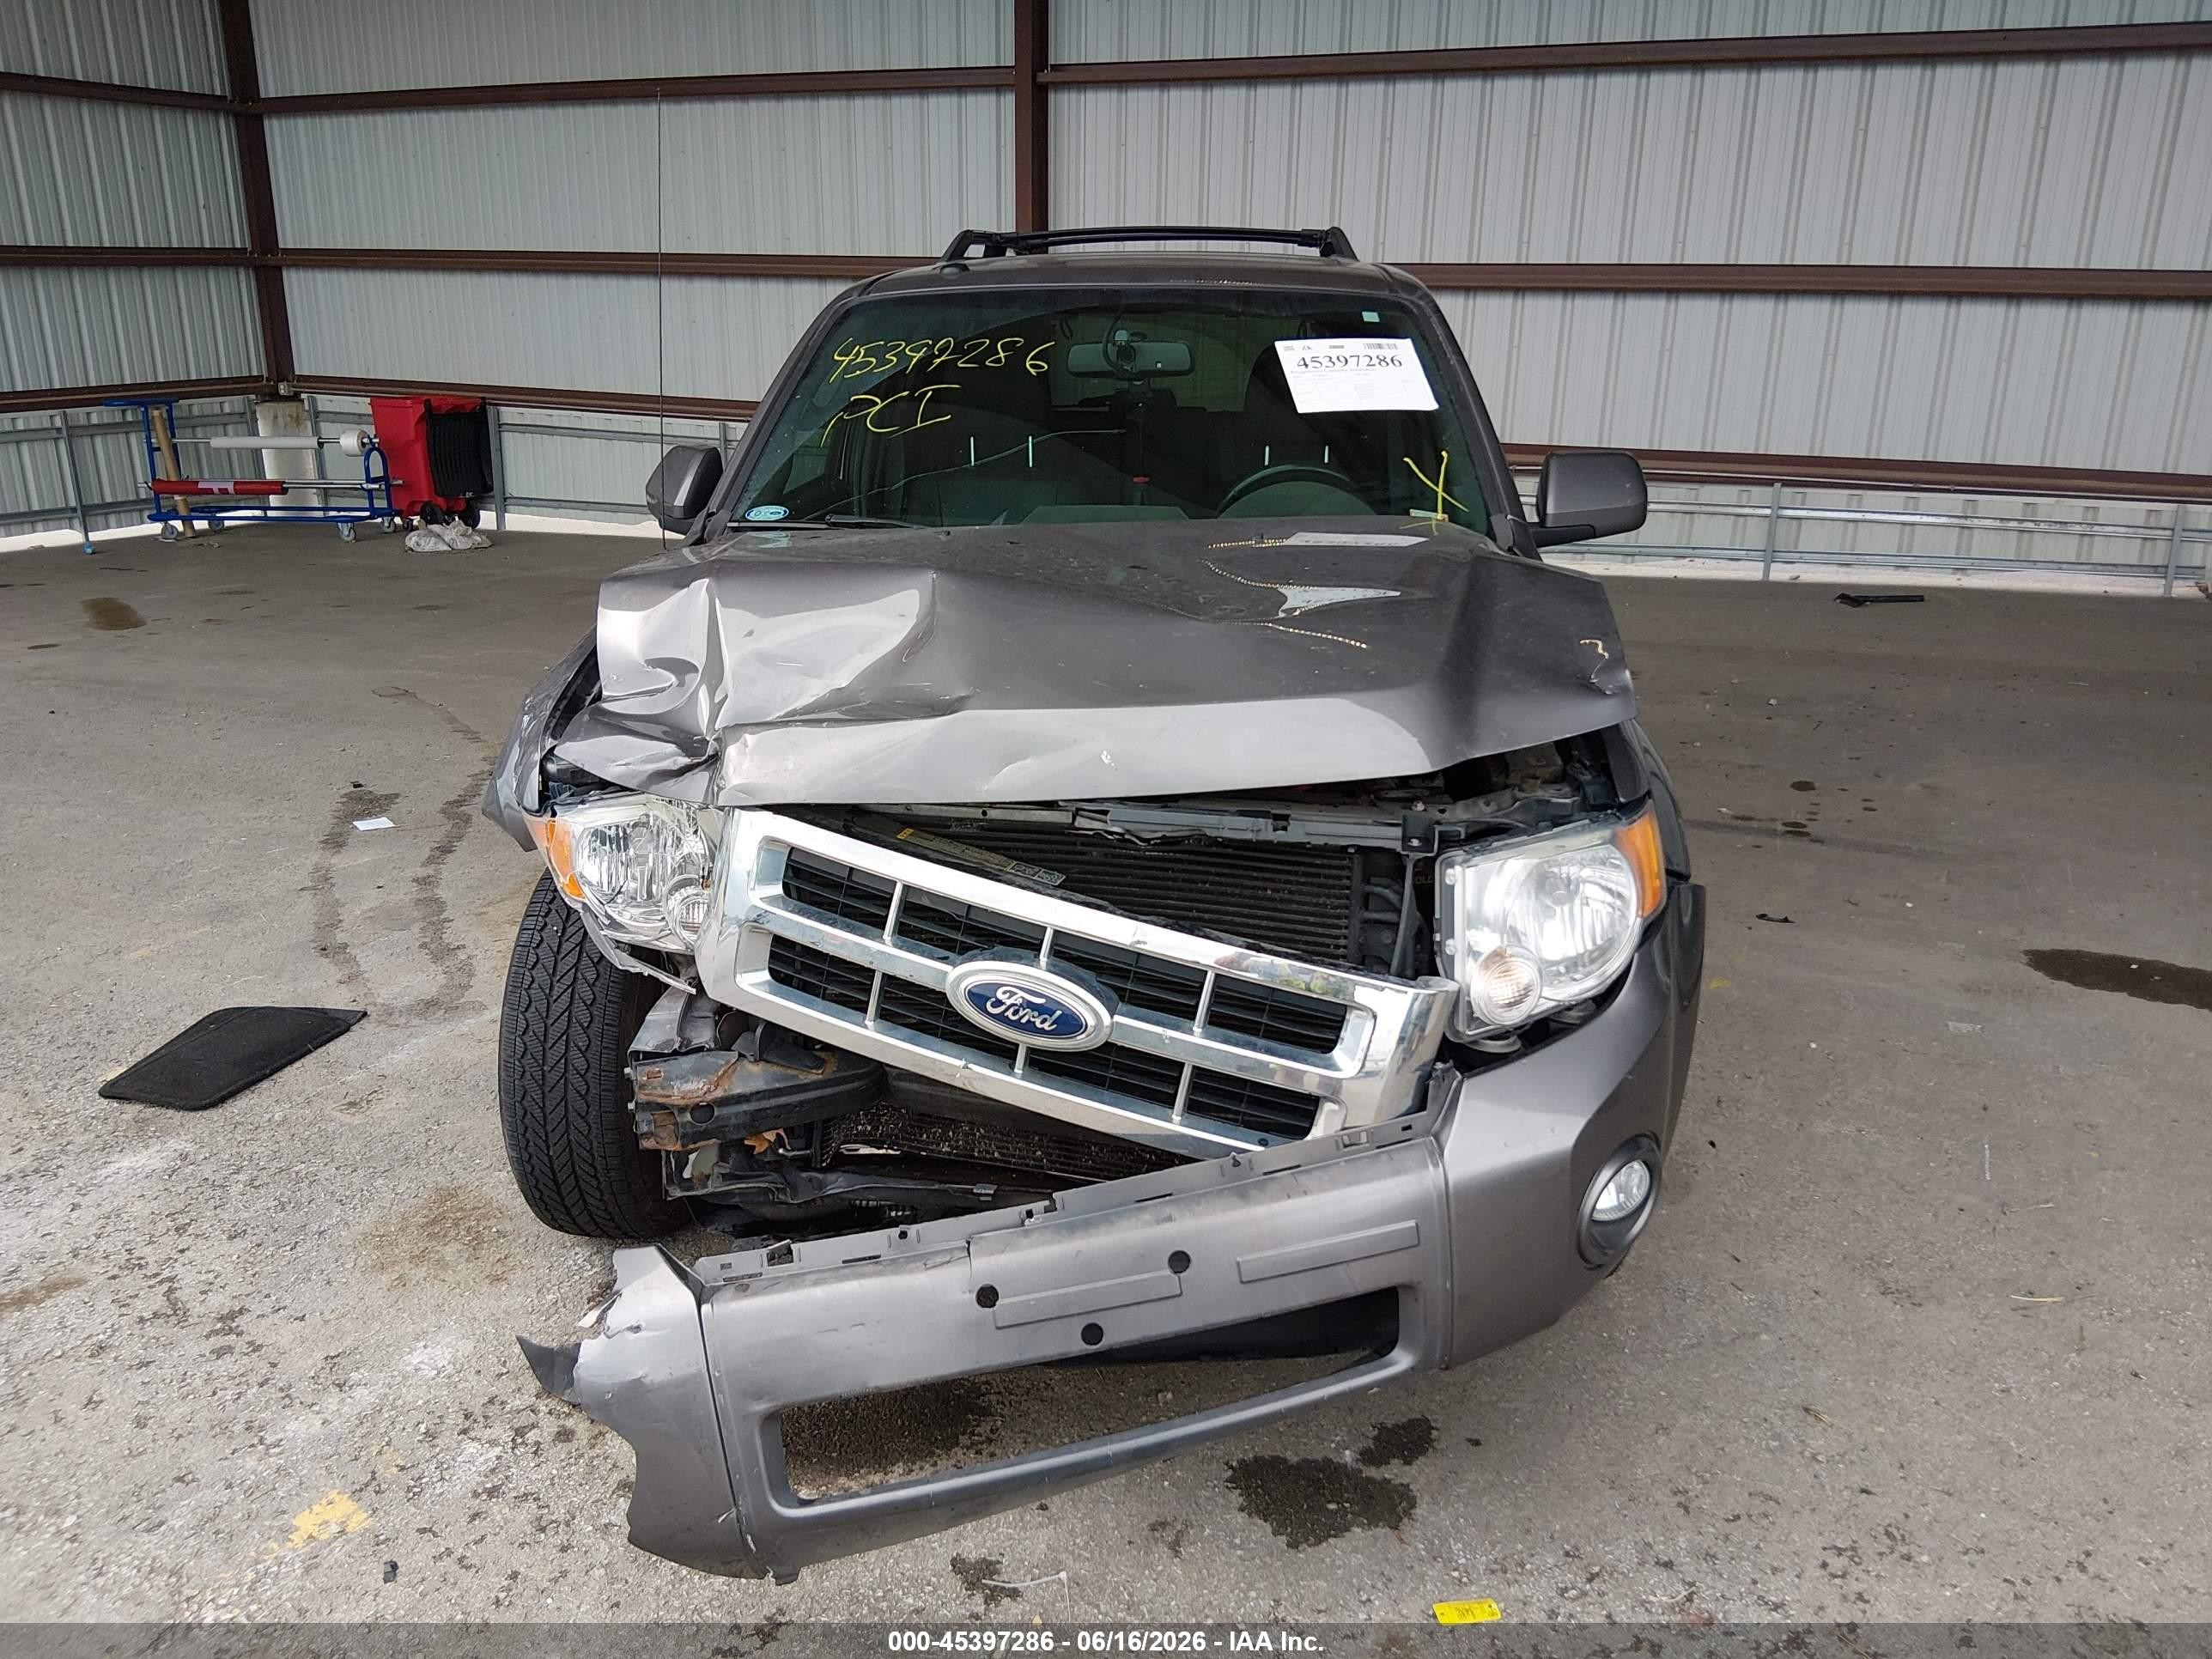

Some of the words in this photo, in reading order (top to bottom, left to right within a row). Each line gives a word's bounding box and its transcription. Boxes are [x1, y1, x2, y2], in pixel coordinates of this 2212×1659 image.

[829, 337, 1055, 384] 45397286
[1296, 354, 1403, 369] 45397286
[986, 985, 1063, 1031] Ford
